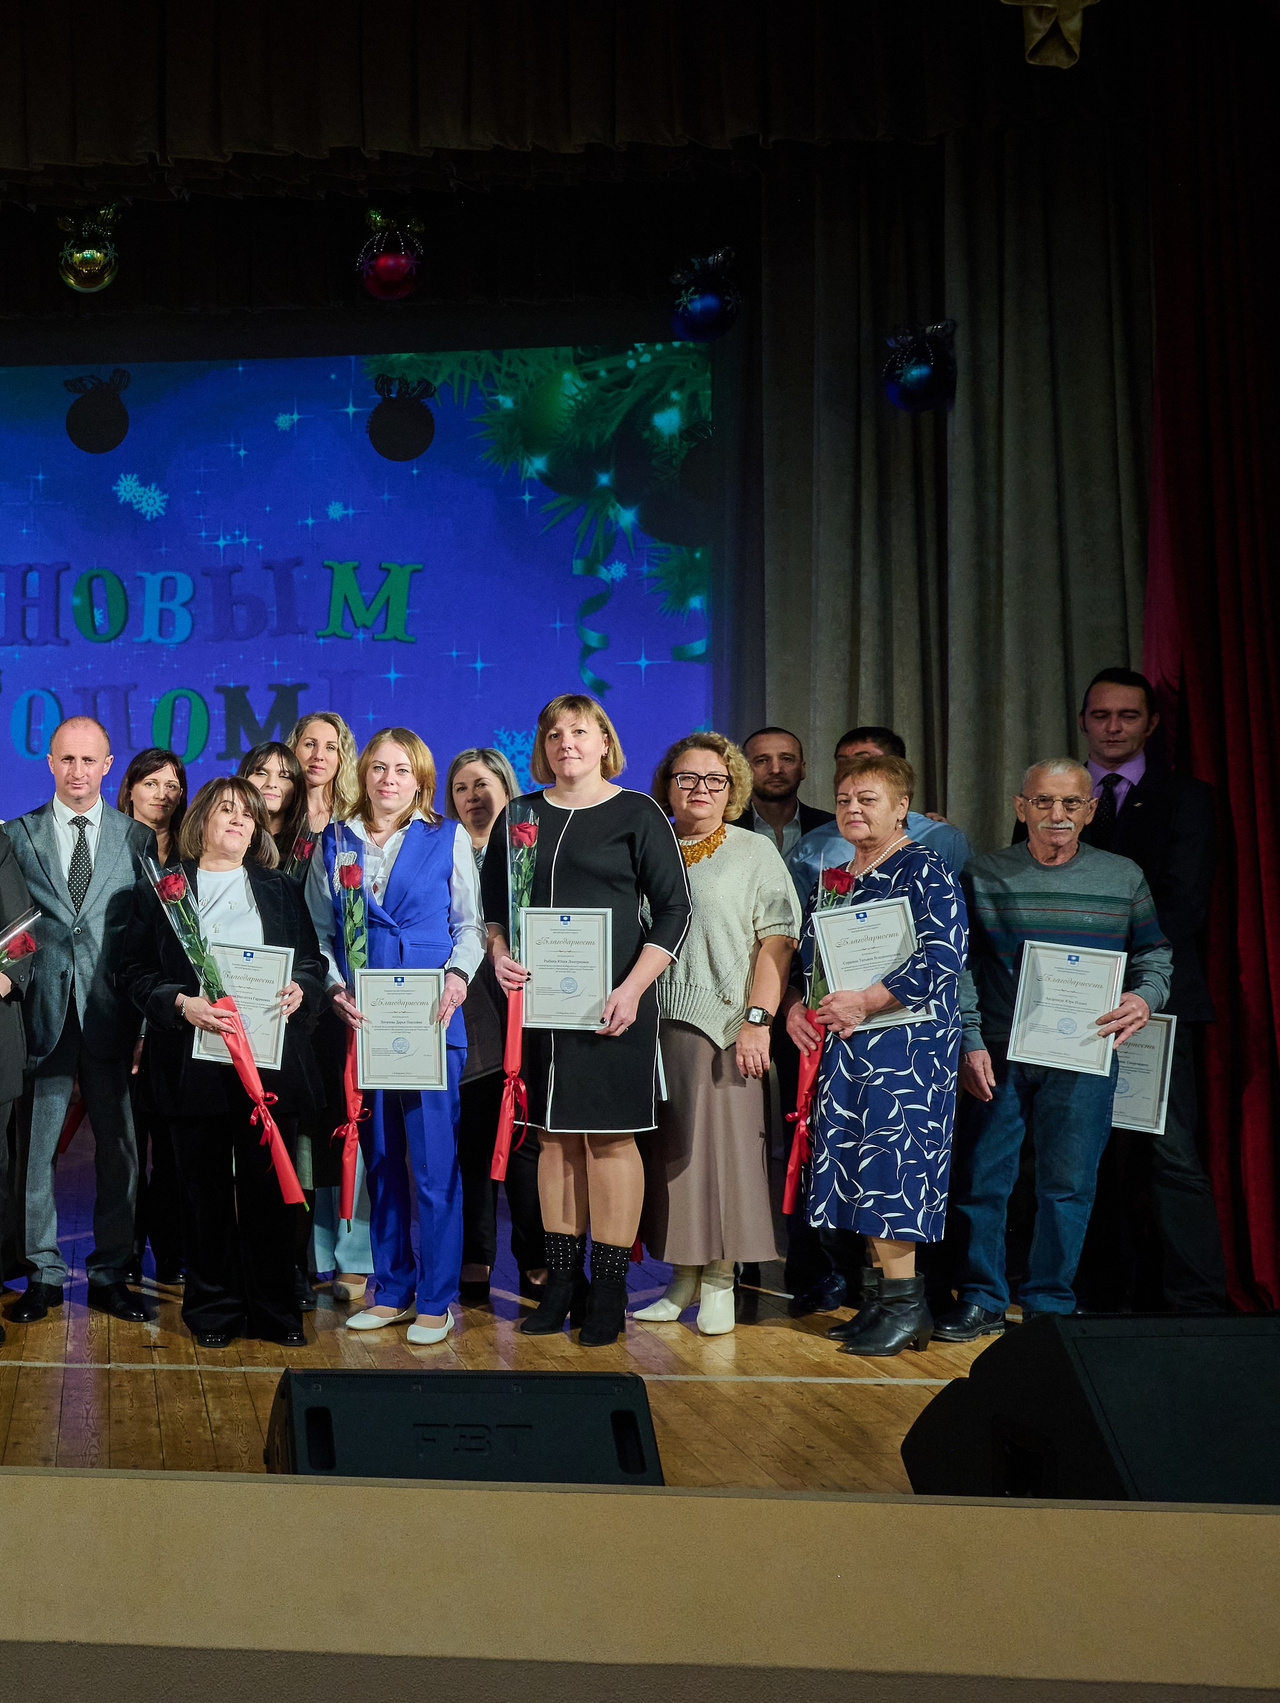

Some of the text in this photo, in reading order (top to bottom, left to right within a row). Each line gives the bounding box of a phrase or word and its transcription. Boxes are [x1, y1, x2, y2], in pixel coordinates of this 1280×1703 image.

[535, 936, 596, 948] Благодарность
[835, 932, 900, 948] Благодарность
[1036, 973, 1104, 989] Благодарность
[370, 997, 430, 1008] Благодарность
[412, 1422, 533, 1457] FBT
